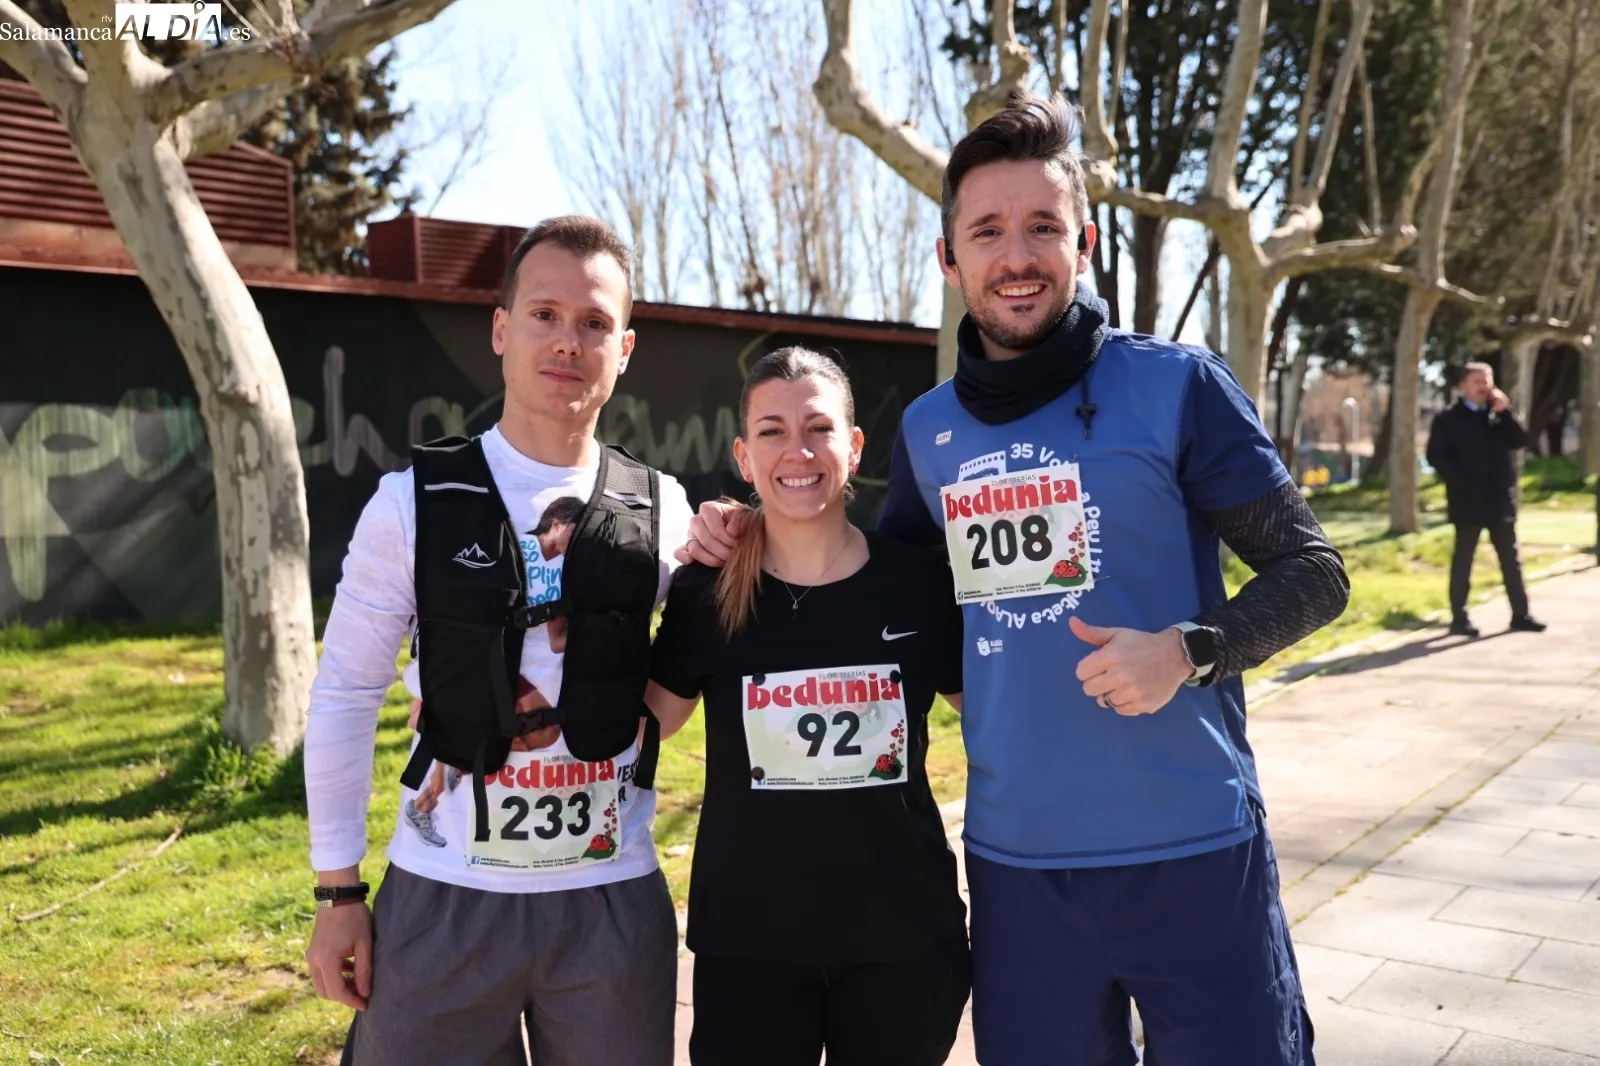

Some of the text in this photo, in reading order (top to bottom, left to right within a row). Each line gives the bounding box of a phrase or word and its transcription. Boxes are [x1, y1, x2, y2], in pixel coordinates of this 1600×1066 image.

[945, 475, 1078, 522] bedunia
[966, 514, 1053, 570] 208
[1010, 442, 1034, 459] 35
[1030, 588, 1086, 625] olteta
[747, 672, 901, 711] bedunia
[797, 710, 862, 757] 92
[484, 757, 616, 789] edunia
[500, 791, 591, 841] 233
